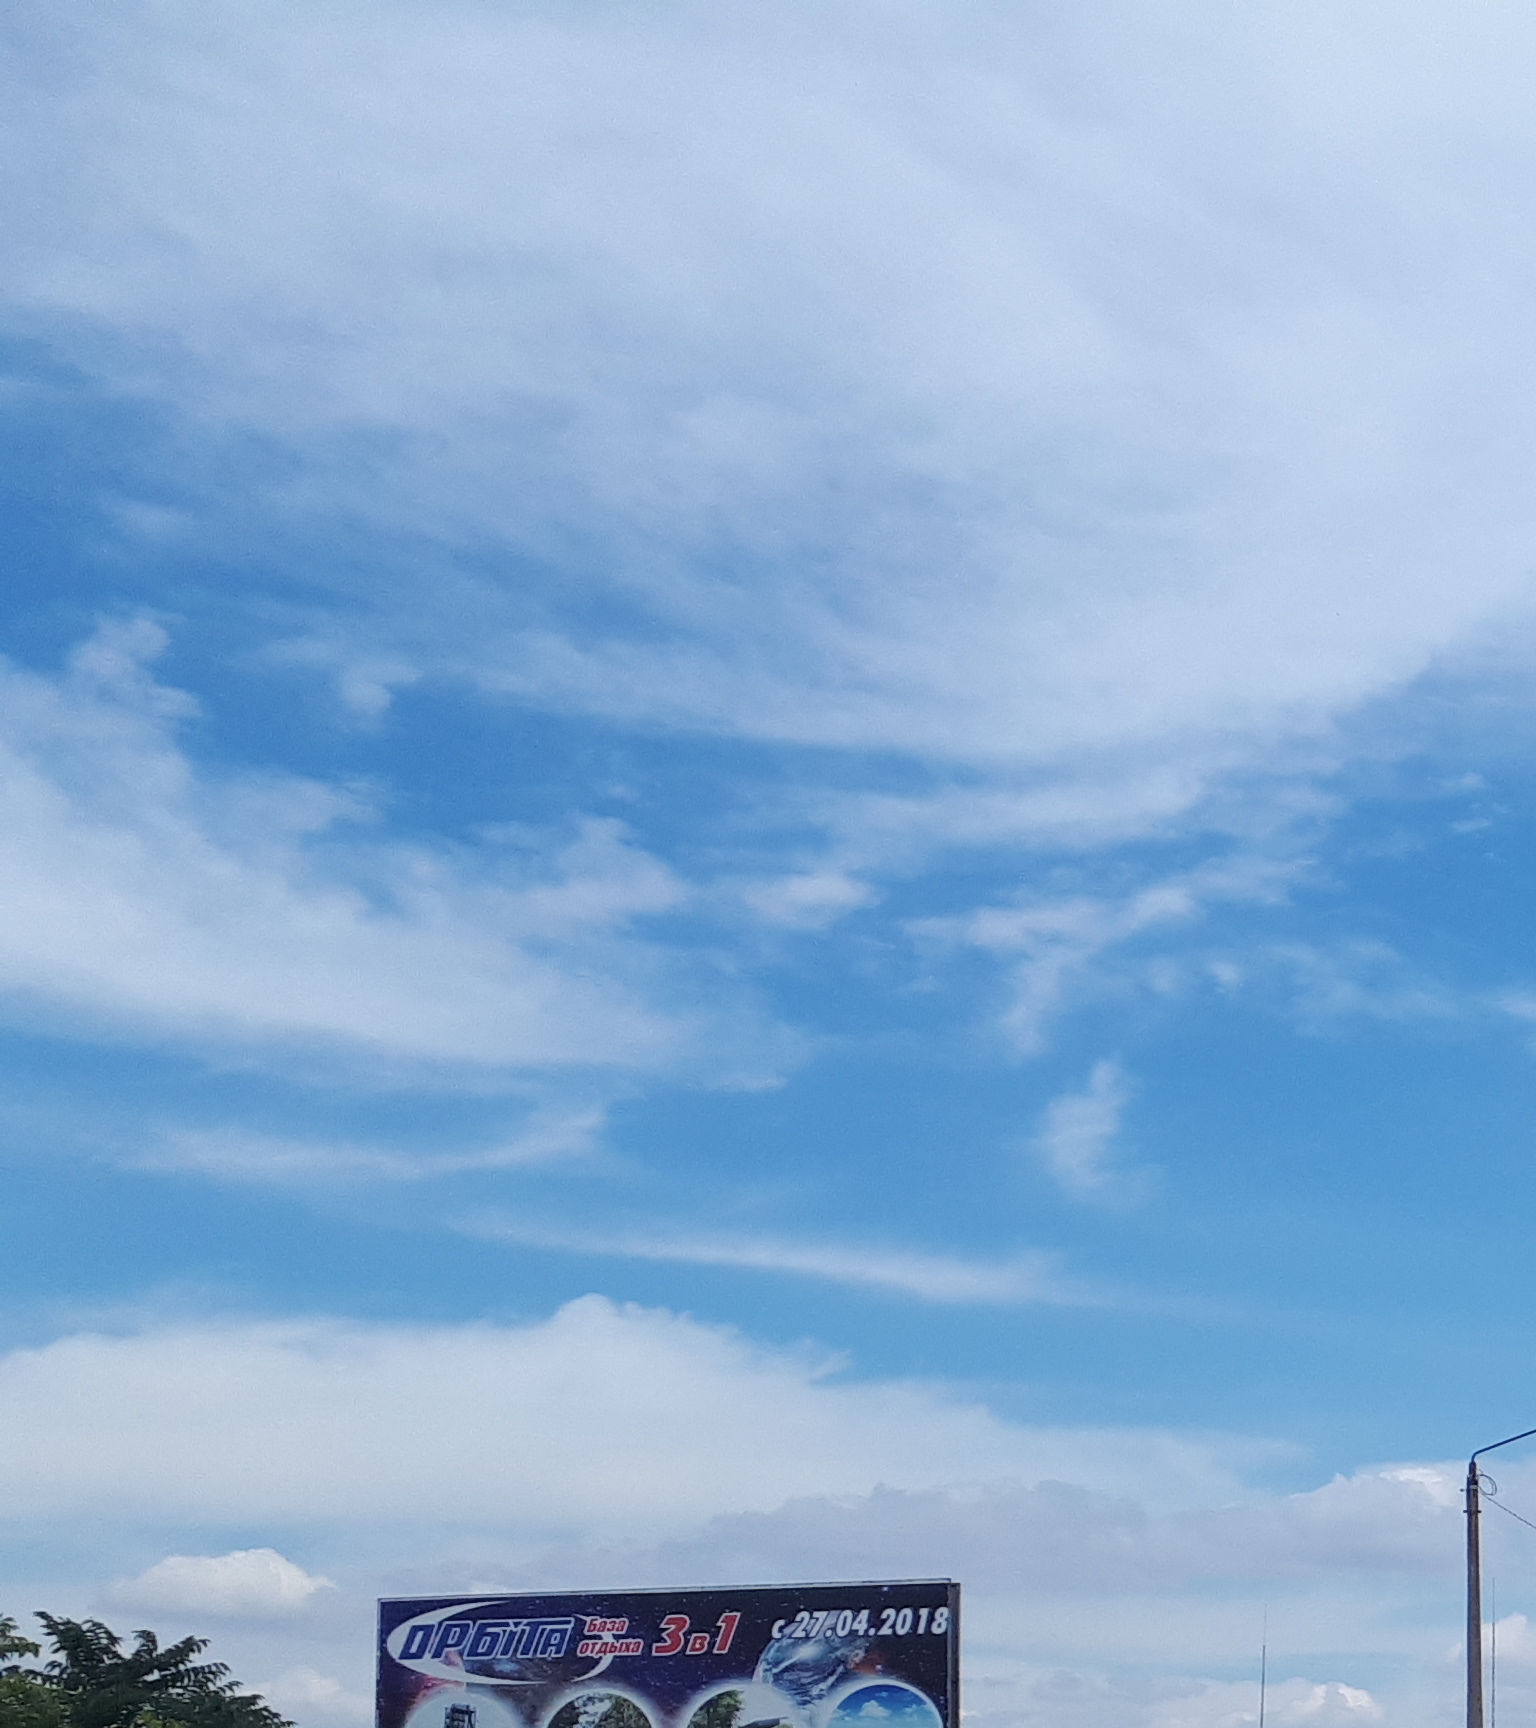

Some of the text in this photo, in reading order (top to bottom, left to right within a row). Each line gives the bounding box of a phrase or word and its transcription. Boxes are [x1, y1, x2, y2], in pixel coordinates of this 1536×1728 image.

[584, 1617, 628, 1635] База
[791, 1606, 949, 1638] 27.04.2018
[576, 1639, 643, 1657] отдыха
